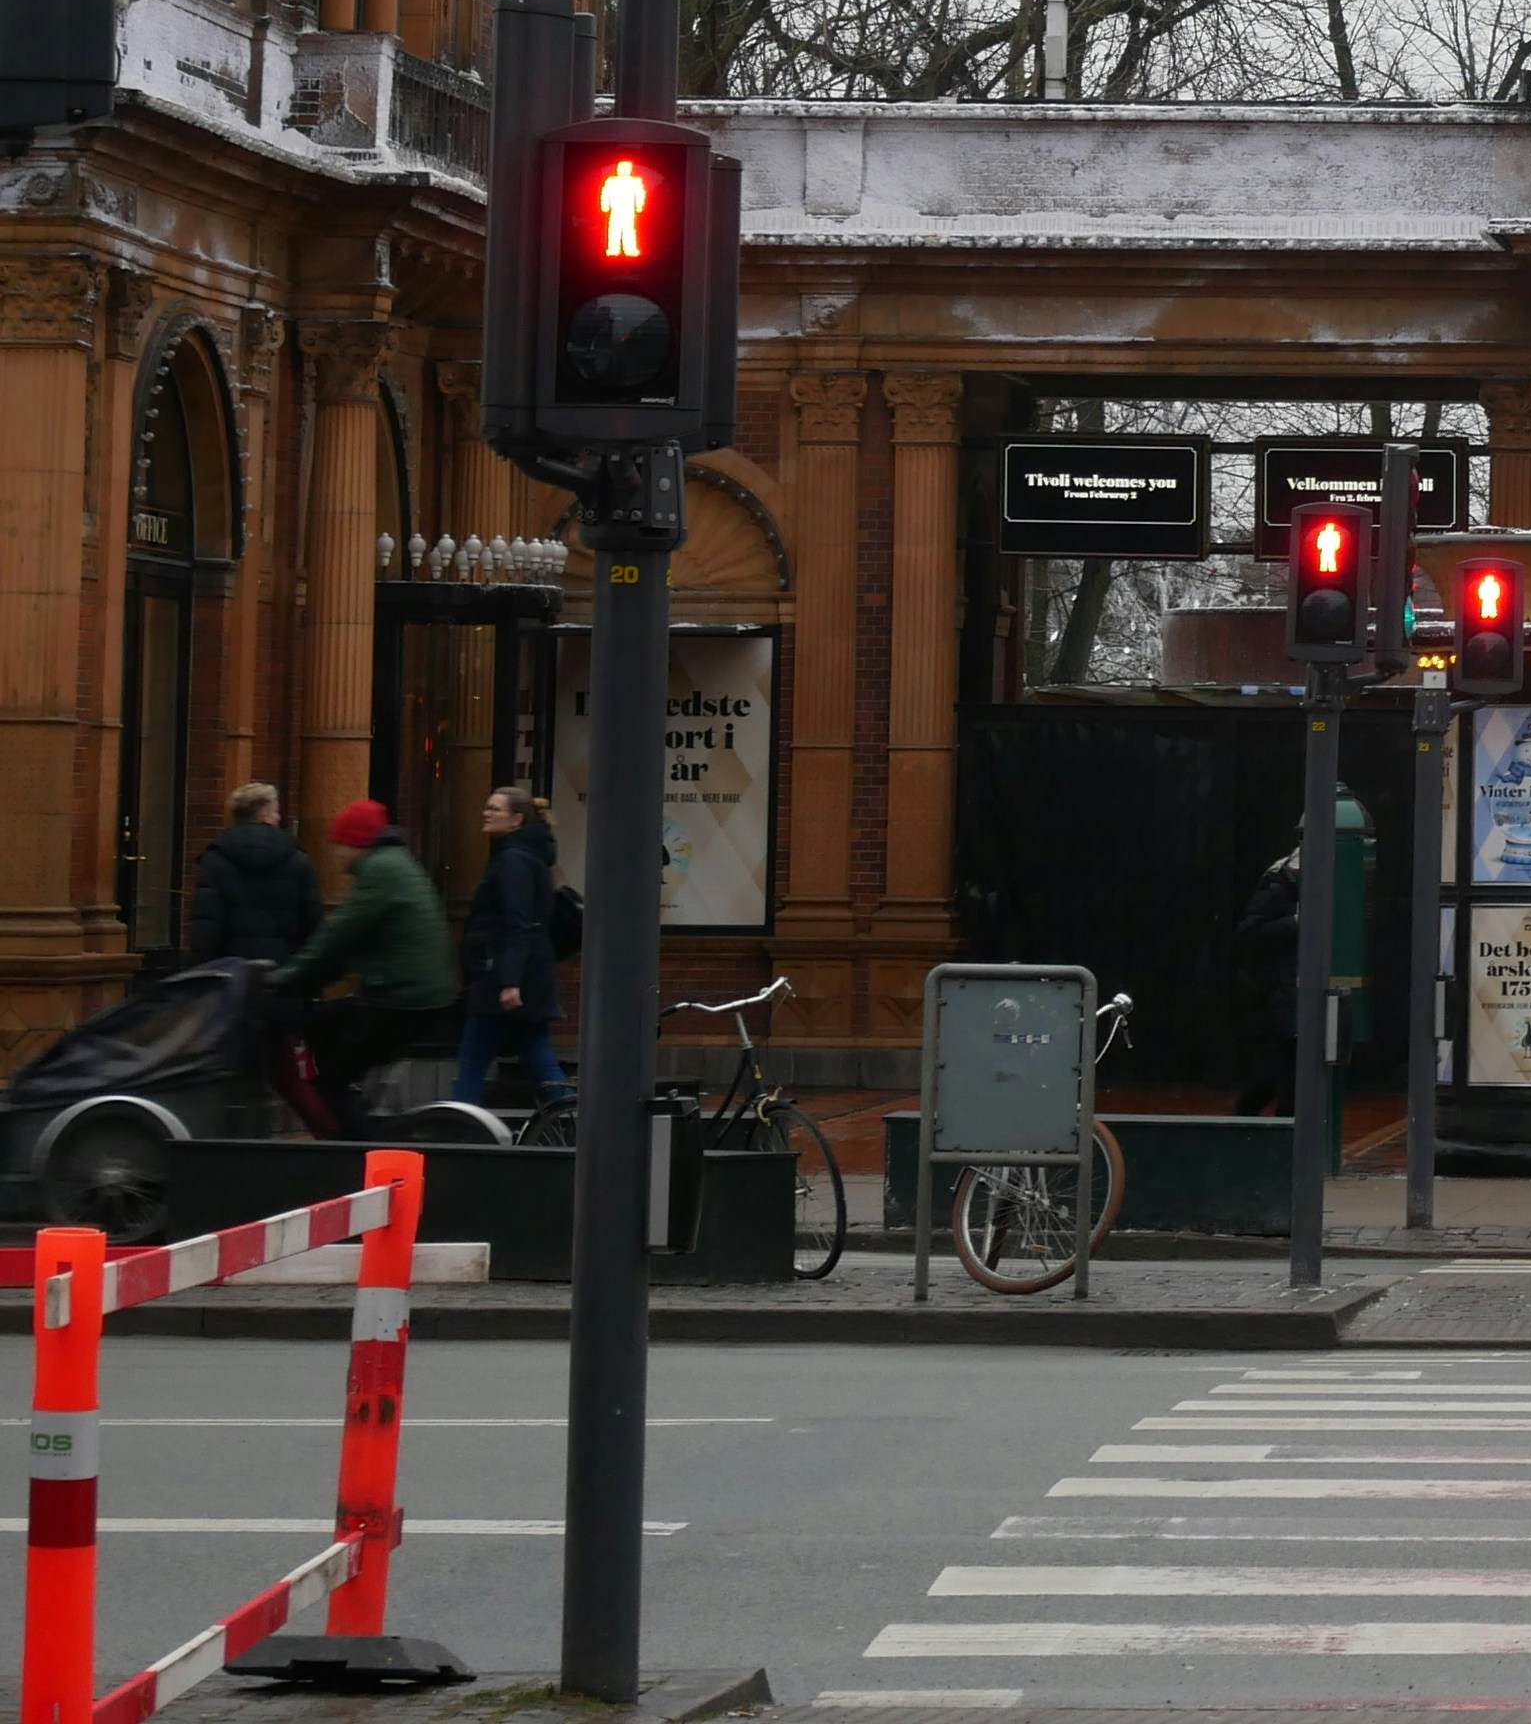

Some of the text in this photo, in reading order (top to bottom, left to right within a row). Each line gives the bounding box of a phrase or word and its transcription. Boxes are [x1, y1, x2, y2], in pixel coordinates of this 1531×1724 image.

[1024, 473, 1177, 492] Tivoli welcomes you
[1286, 477, 1378, 491] Velkommen
[610, 565, 640, 584] 20
[667, 691, 750, 717] edste
[725, 723, 734, 749] i
[1311, 721, 1327, 733] 22
[670, 755, 709, 781] år
[1480, 785, 1527, 798] Vinter
[1479, 942, 1512, 958] Det
[1500, 981, 1531, 997] 175
[32, 1433, 73, 1451] OS
